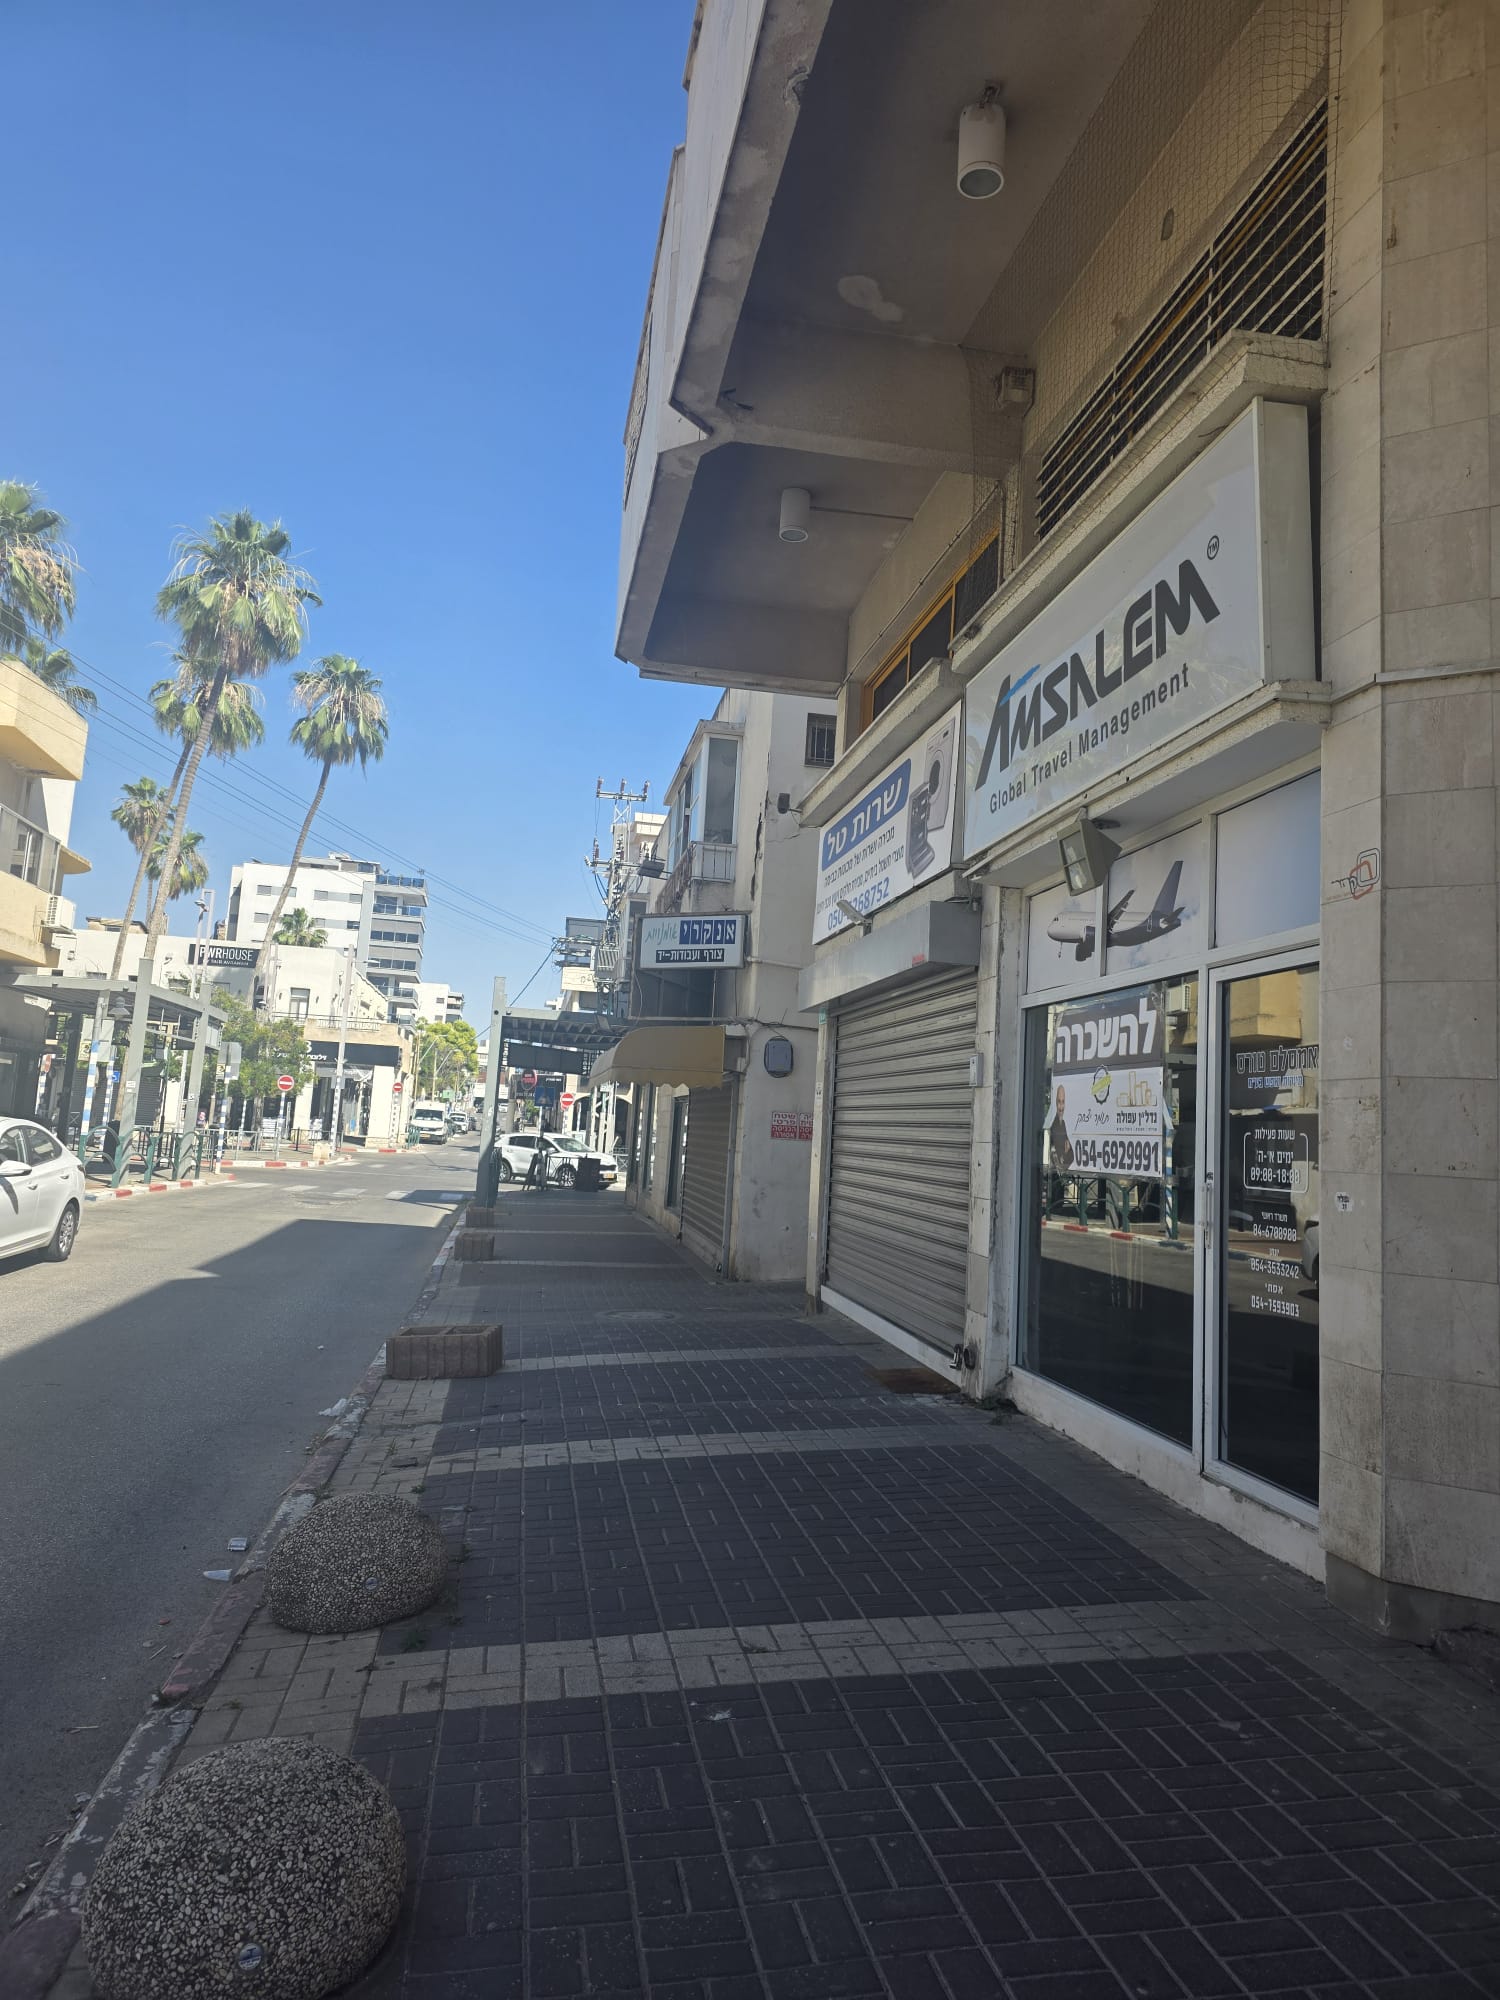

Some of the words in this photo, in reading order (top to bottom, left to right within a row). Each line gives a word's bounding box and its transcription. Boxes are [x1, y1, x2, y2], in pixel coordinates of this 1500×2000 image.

[975, 559, 1221, 791] AMSALEM
[989, 779, 1027, 814] Global
[1031, 740, 1072, 787] Travel
[1078, 662, 1189, 757] Management
[850, 776, 903, 843] שרות
[826, 829, 848, 861] טל
[683, 922, 735, 943] אנקרי
[657, 950, 701, 961] ועבודות-יד
[703, 949, 723, 962] צורף
[1056, 997, 1158, 1064] להשכרה
[1235, 1051, 1266, 1074] טורס
[1269, 1045, 1319, 1072] אמסלם
[1116, 1111, 1137, 1125] עפולה
[1254, 1127, 1277, 1140] פעילות
[1277, 1129, 1296, 1141] שעות
[1075, 1139, 1160, 1172] 054-6929991
[1276, 1151, 1294, 1164] ימים
[1250, 1167, 1300, 1184] 09:00-18:00
[1274, 1213, 1288, 1223] משרד
[1250, 1257, 1299, 1279] 054-3533242
